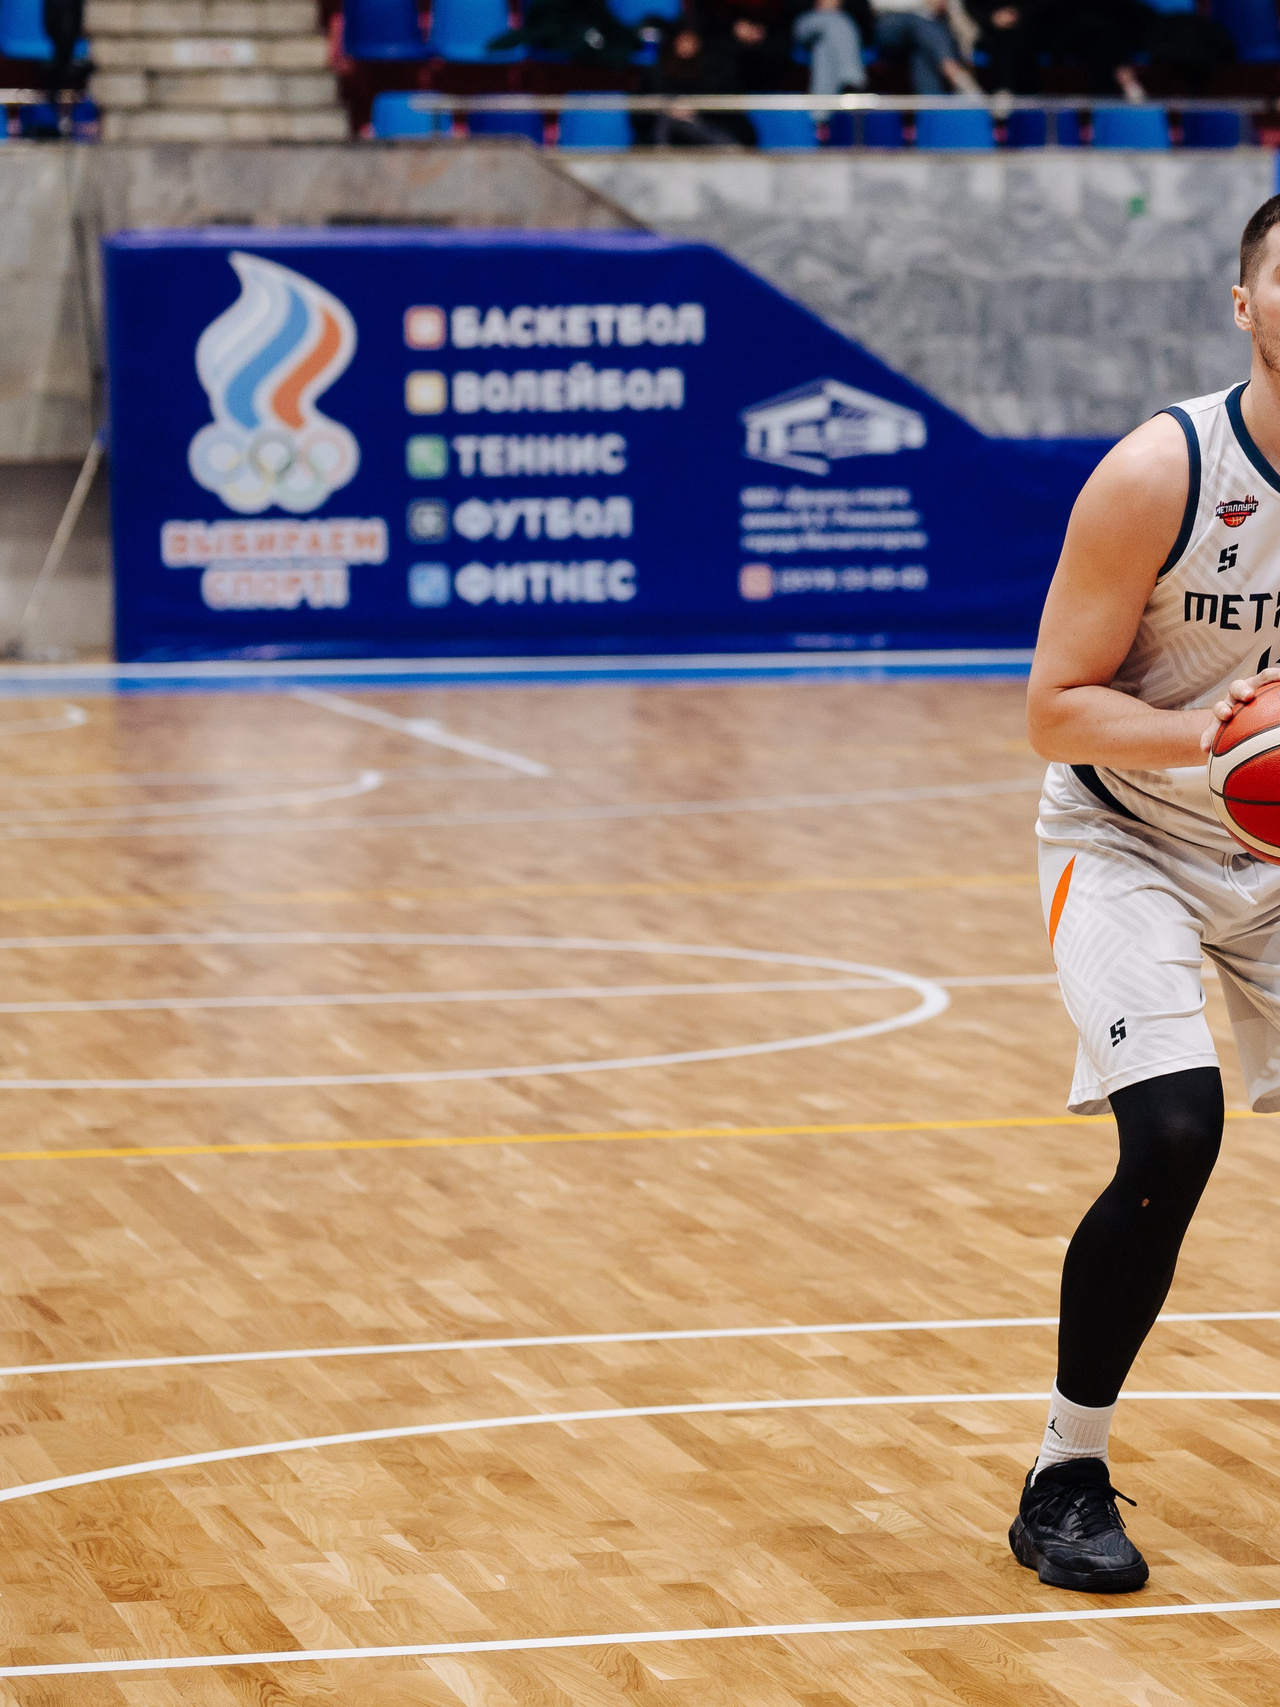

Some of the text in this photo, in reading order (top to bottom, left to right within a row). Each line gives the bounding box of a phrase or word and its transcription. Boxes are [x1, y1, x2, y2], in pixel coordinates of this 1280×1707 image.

[452, 304, 705, 348] БАСКЕТБОЛ
[453, 361, 685, 413] ВОЛЕЙБОЛ
[453, 433, 627, 478] ТЕННИС
[453, 497, 634, 541] ФУТБОЛ
[1216, 502, 1257, 515] МЕТАЛЛУРГ
[454, 560, 637, 605] ФИТНЕС
